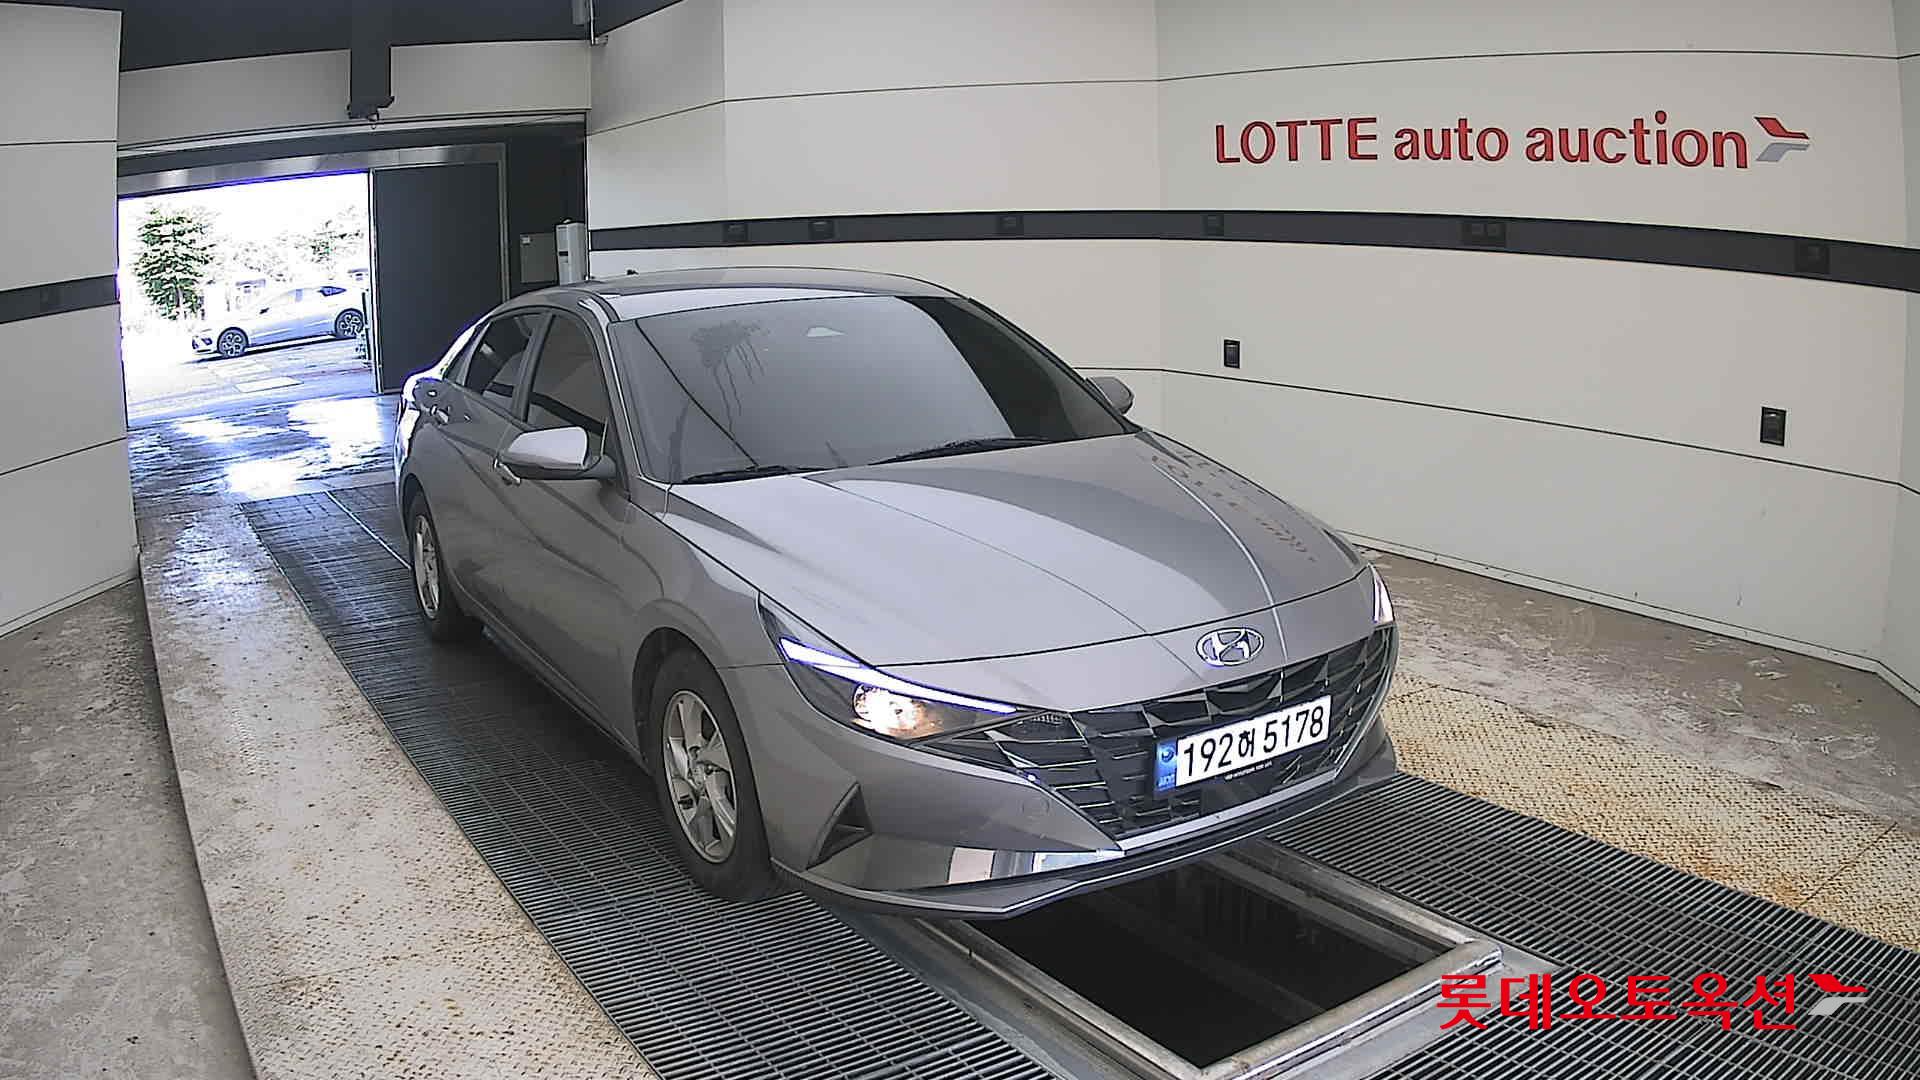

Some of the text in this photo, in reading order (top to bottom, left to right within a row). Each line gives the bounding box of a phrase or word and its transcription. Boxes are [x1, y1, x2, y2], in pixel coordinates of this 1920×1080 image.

[1215, 110, 1749, 169] LOTTE auto auction
[1183, 727, 1256, 777] 192허
[1263, 705, 1325, 754] 5178
